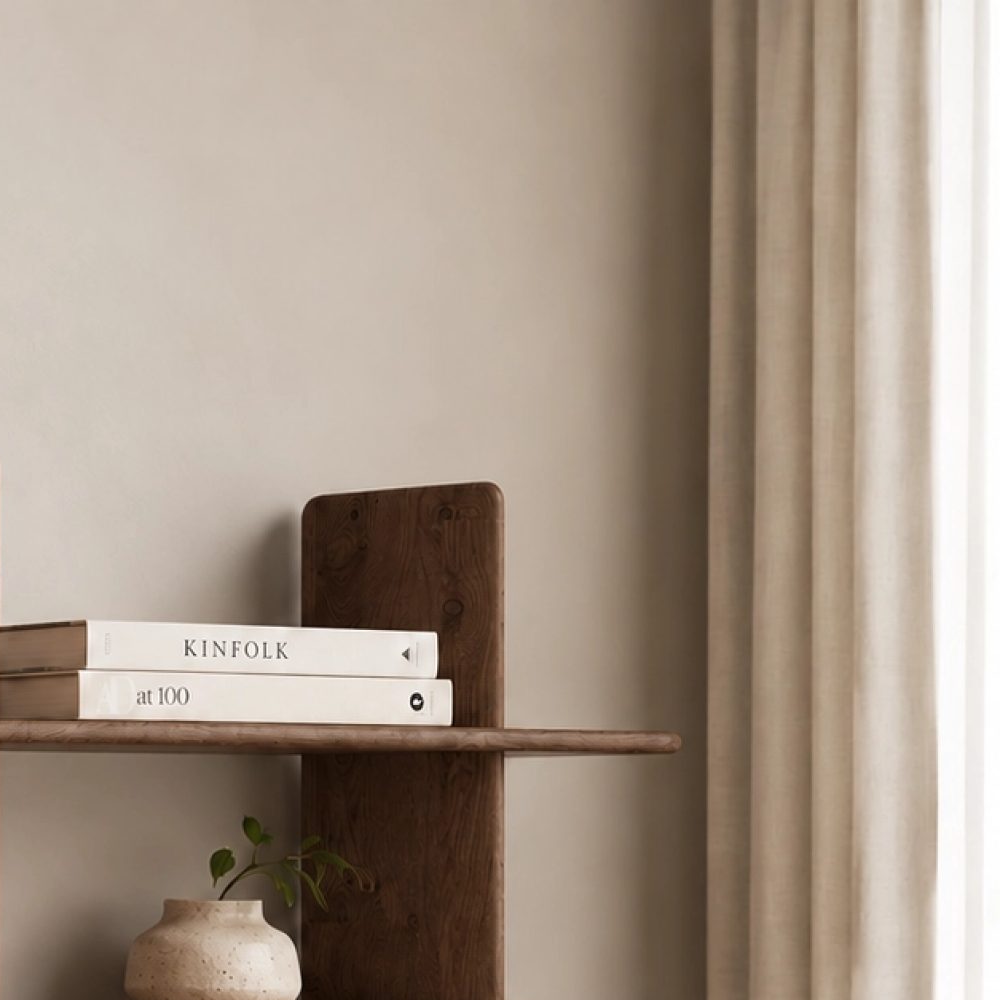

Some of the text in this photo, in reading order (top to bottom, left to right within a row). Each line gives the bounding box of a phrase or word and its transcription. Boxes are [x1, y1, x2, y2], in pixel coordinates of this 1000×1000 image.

[183, 638, 289, 660] KINFOLK
[136, 688, 153, 706] at
[158, 685, 191, 706] 100
